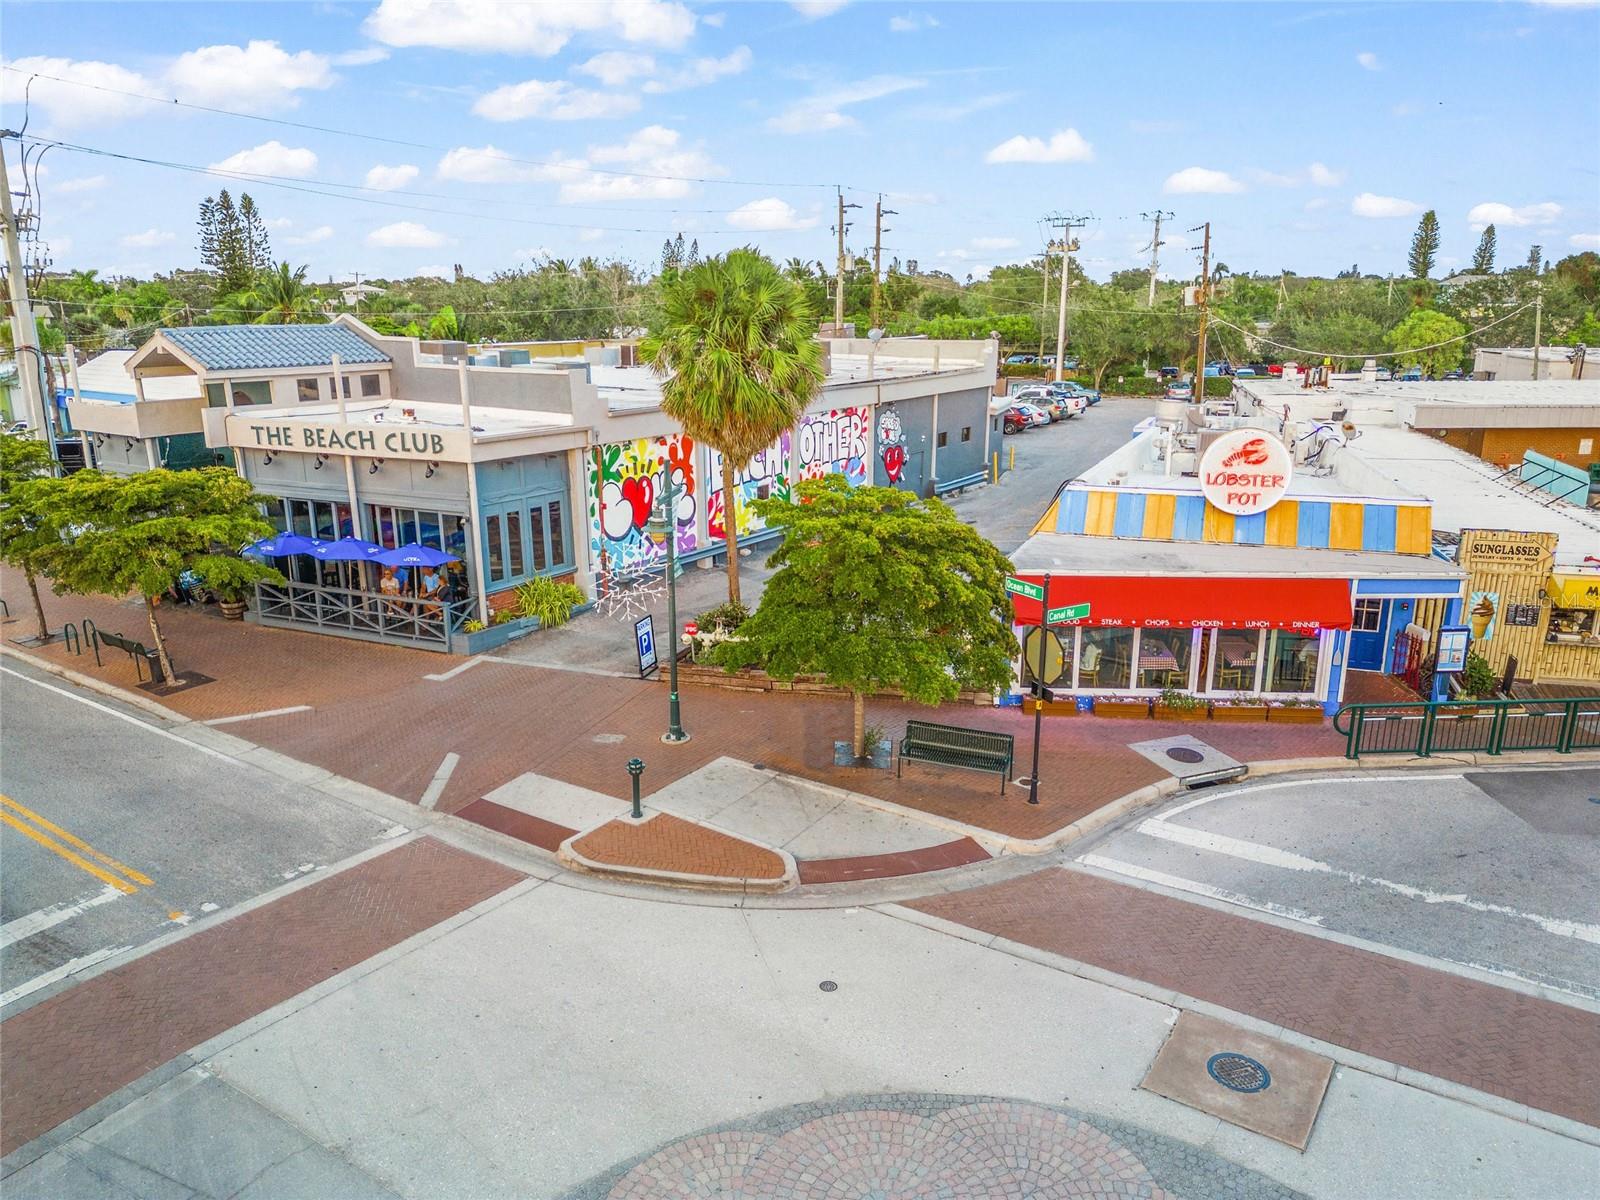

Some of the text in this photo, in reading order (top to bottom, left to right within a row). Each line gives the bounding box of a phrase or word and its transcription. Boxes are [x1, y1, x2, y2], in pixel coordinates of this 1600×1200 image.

[250, 426, 444, 454] THE BEACH CLUB
[799, 413, 866, 465] OTHER
[1206, 472, 1284, 488] LOBSTER
[1227, 492, 1261, 506] POT
[1473, 543, 1540, 556] SUNGLASSES
[1007, 580, 1037, 597] Ocean Blvd
[1049, 610, 1066, 621] Canal
[1066, 609, 1075, 618] Rd
[641, 634, 648, 654] P
